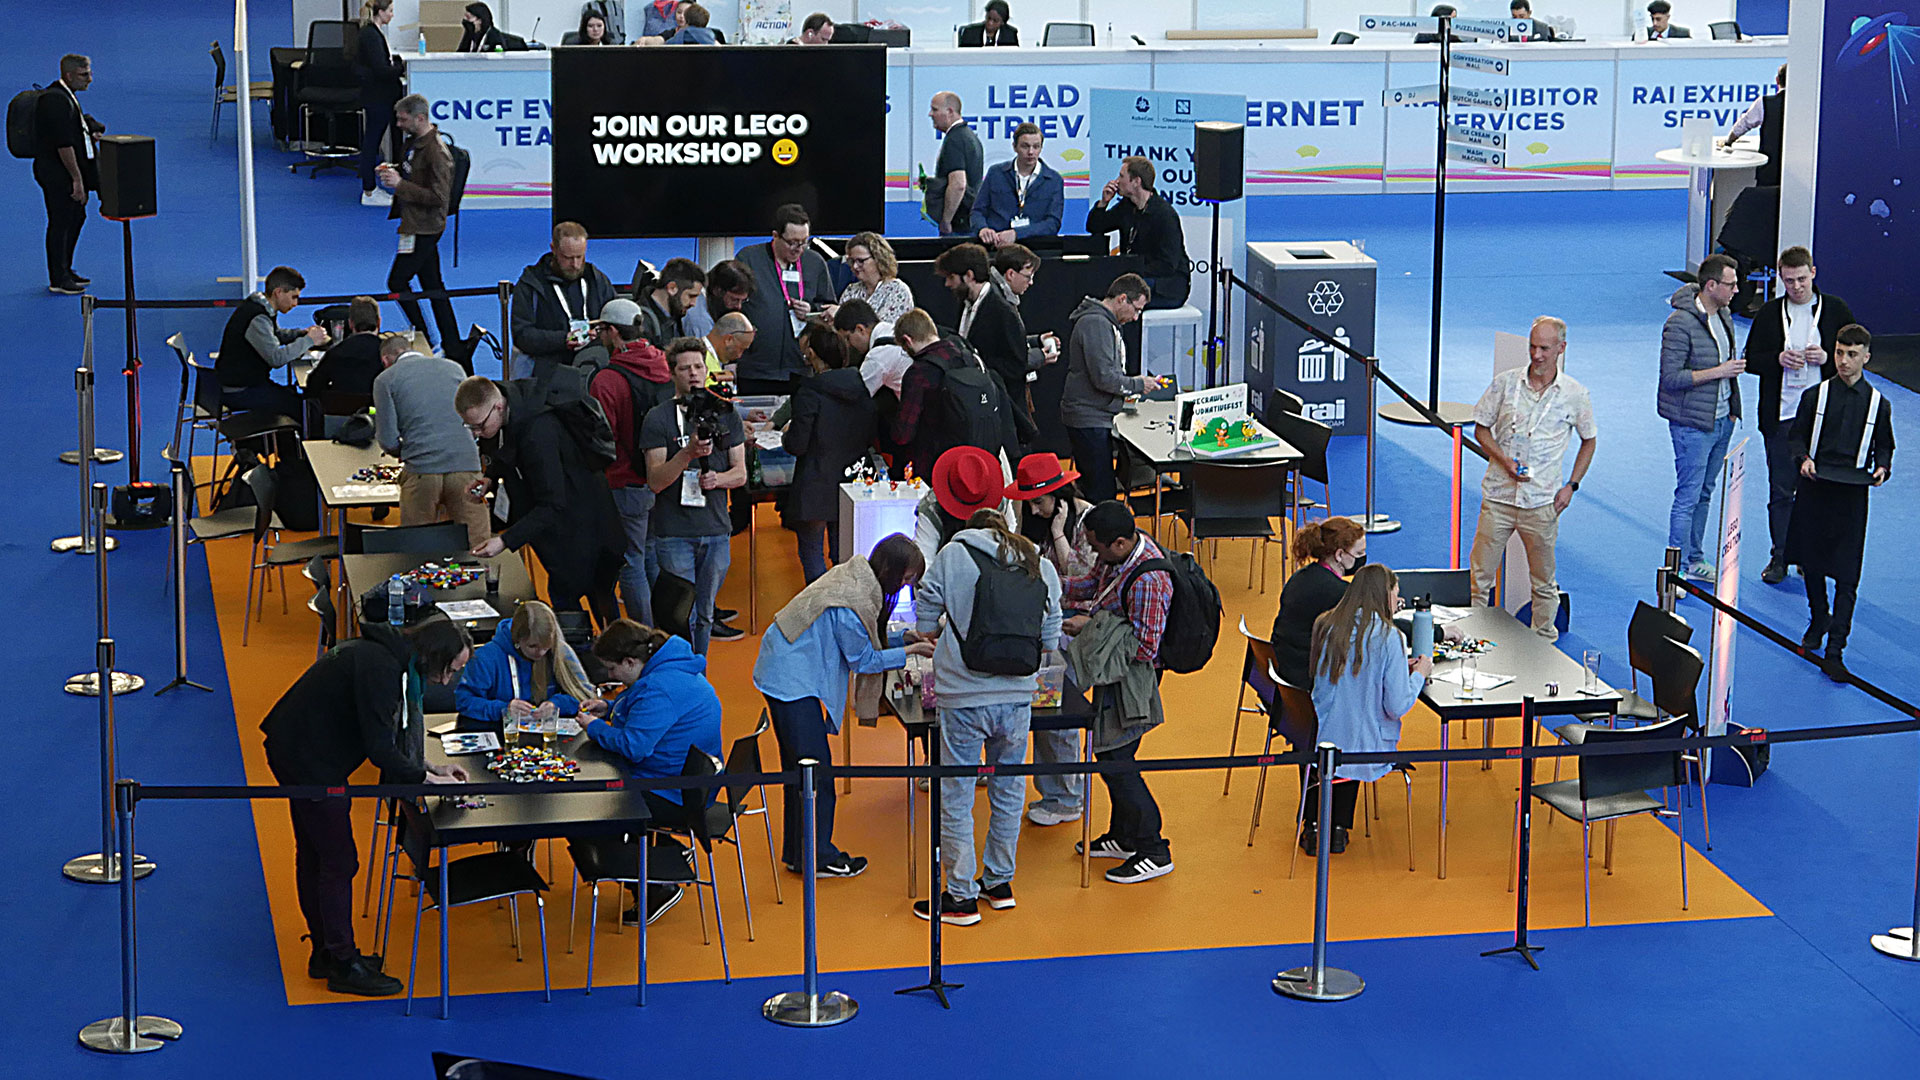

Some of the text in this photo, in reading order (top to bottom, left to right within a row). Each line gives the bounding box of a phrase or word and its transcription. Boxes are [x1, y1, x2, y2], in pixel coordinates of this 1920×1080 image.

[1455, 24, 1496, 35] PUZZLEMANIA
[1453, 54, 1494, 65] CONVERSATION
[987, 85, 1080, 108] LEAD
[1472, 98, 1493, 106] GAMES
[1633, 86, 1675, 104] RAI
[431, 99, 513, 120] CNCF
[592, 114, 809, 137] JOIN OUR LEGO
[1440, 112, 1565, 131] ERVICES
[592, 142, 762, 165] WORKSHOP
[1104, 144, 1178, 162] THANK
[1462, 154, 1487, 164] MACHINE
[1301, 399, 1345, 420] rai
